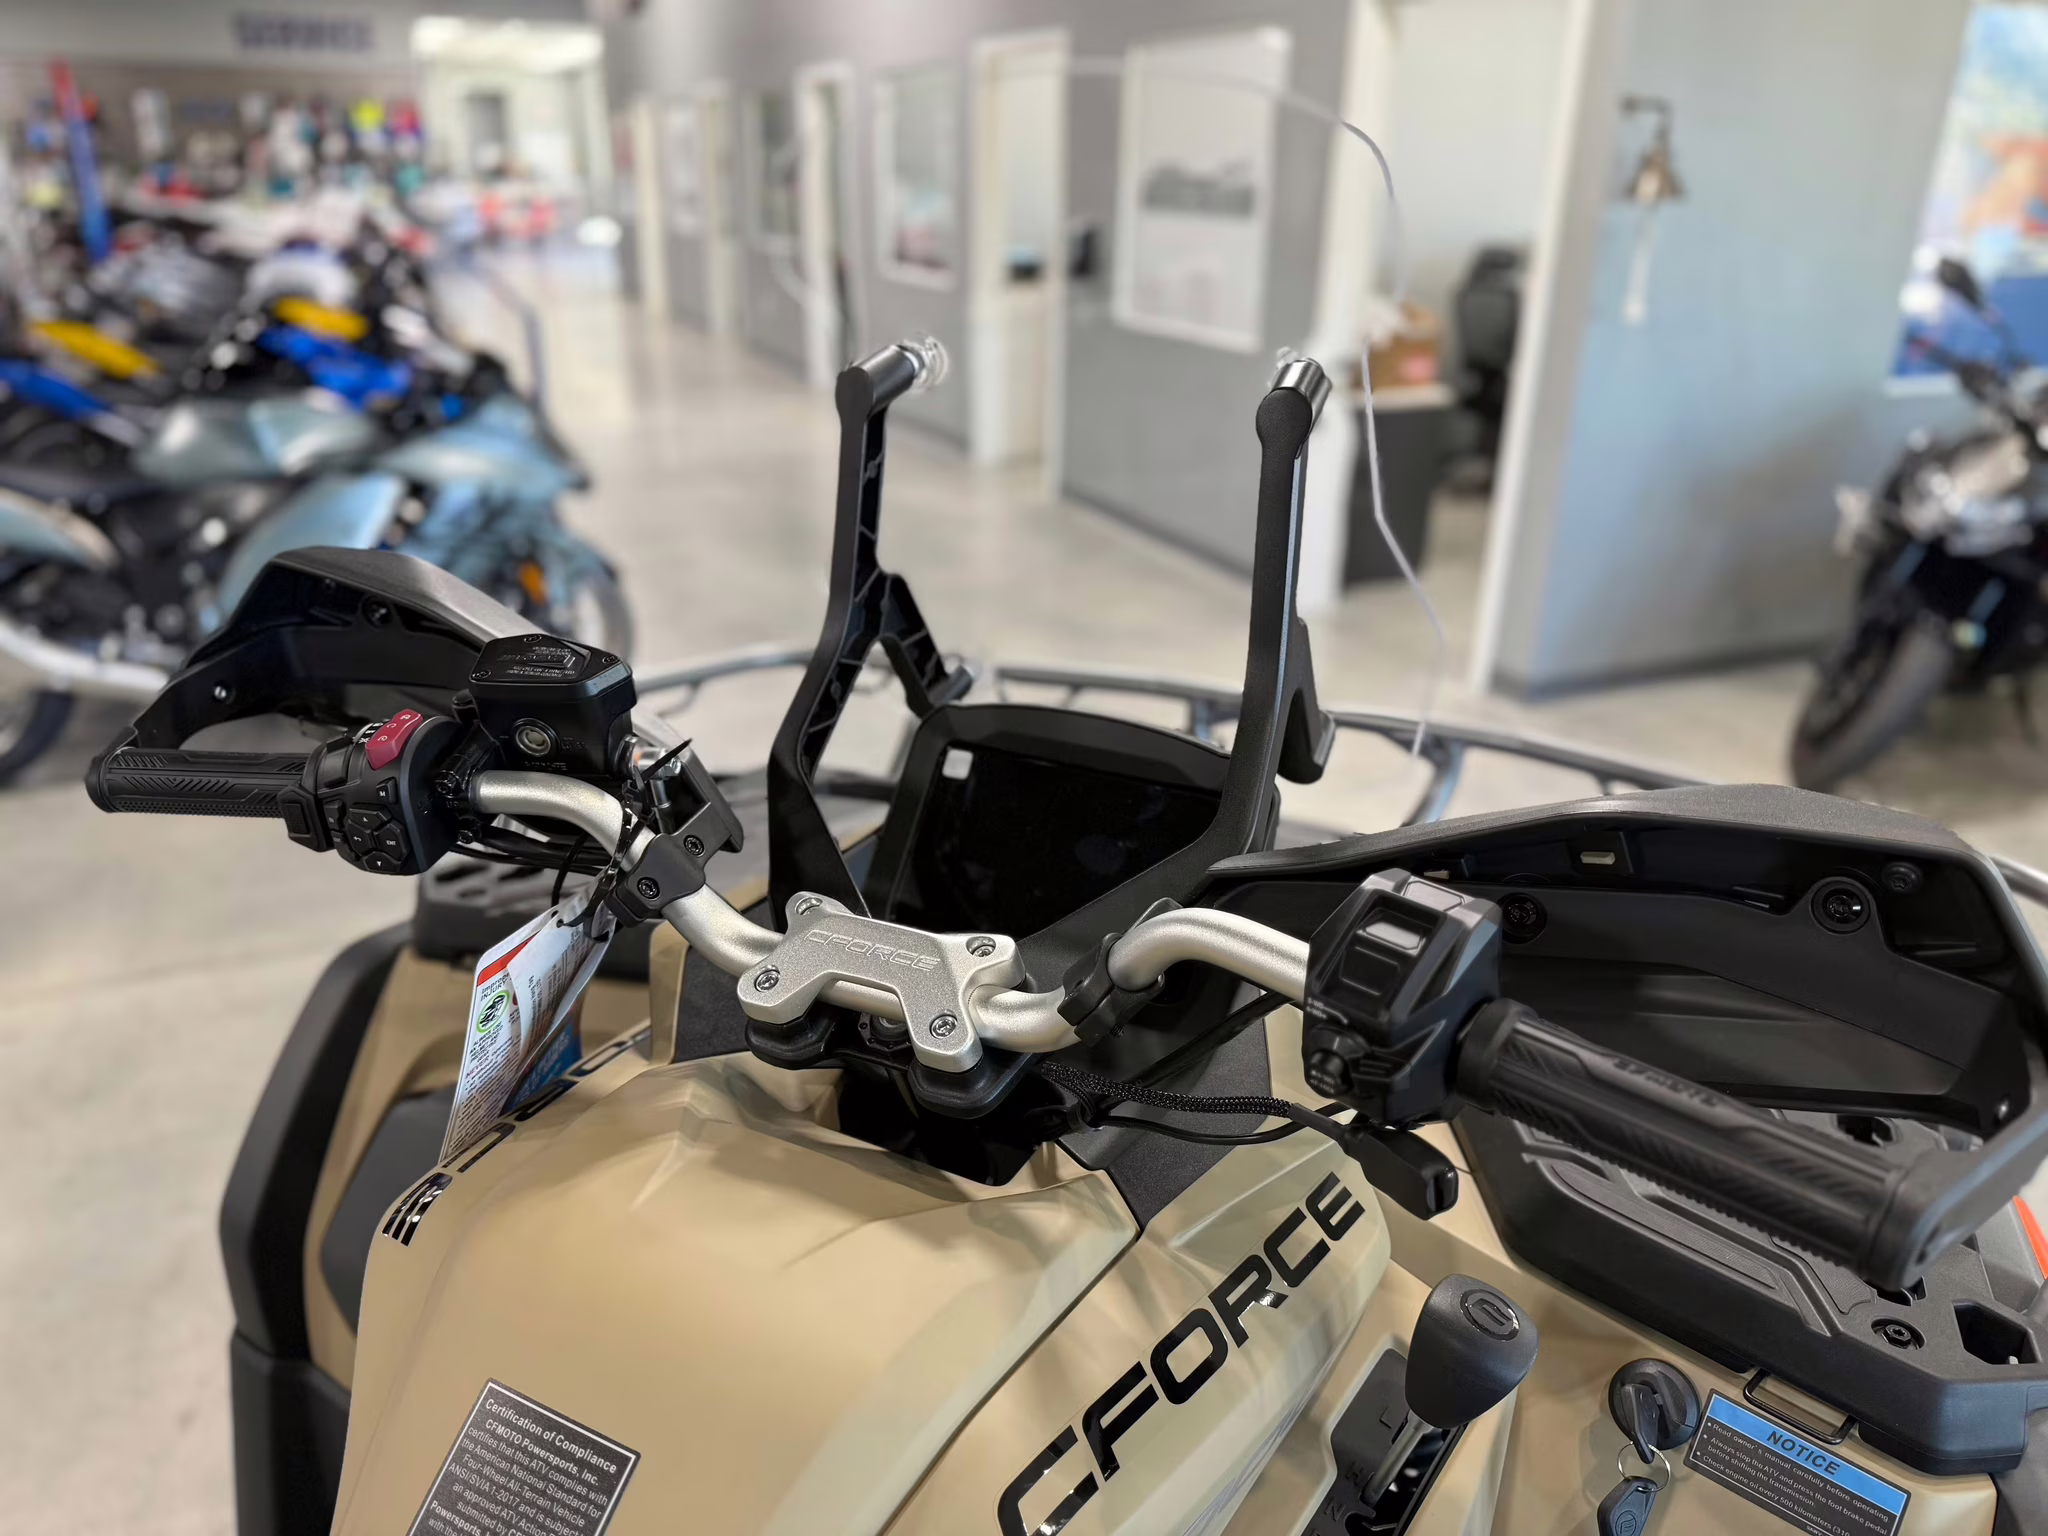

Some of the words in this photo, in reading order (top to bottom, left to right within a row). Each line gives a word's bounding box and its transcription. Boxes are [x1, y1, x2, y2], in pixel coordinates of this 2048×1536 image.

[804, 930, 940, 971] CFORCE
[998, 1171, 1366, 1536] CFORCE
[466, 1425, 499, 1448] certifies
[497, 1441, 516, 1457] that
[513, 1450, 531, 1466] this
[529, 1458, 550, 1475] ATV
[547, 1468, 590, 1497] complies
[587, 1489, 609, 1506] with
[484, 1398, 545, 1436] Certification
[542, 1428, 557, 1442] of
[553, 1434, 619, 1476] Compliance
[484, 1418, 524, 1445] CFMOTO
[520, 1437, 583, 1477] Powersports,
[581, 1468, 602, 1486] Inc.
[1707, 1444, 1731, 1461] before
[1729, 1457, 1757, 1476] shifting
[1756, 1471, 1769, 1482] the
[1712, 1423, 1732, 1438] Read
[1764, 1451, 1792, 1470] manual
[1792, 1466, 1825, 1488] carefully
[1825, 1483, 1851, 1501] before
[1766, 1429, 1841, 1477] NOTICE
[447, 1461, 493, 1493] ANSI/SVIA
[489, 1485, 521, 1508] 1-2017
[518, 1501, 537, 1518] and
[535, 1510, 547, 1523] is
[452, 1482, 465, 1494] an
[462, 1488, 503, 1516] approved
[499, 1507, 521, 1525] ATV
[461, 1437, 476, 1451] the
[472, 1444, 513, 1471] American
[509, 1464, 548, 1490] National
[545, 1483, 589, 1512] Standard
[586, 1504, 603, 1519] for
[461, 1453, 510, 1486] Four-Wheel
[506, 1478, 554, 1509] All-Terrain
[550, 1502, 588, 1528] Vehicle
[1702, 1454, 1726, 1471] Check
[1724, 1467, 1750, 1485] engine
[1749, 1480, 1760, 1490] oil
[1758, 1486, 1780, 1501] every
[1779, 1496, 1794, 1509] 500
[1793, 1504, 1833, 1530] kilometers
[1710, 1437, 1737, 1455] Always
[1734, 1450, 1752, 1464] stop
[1751, 1459, 1765, 1470] the
[1763, 1465, 1780, 1477] ATV
[1778, 1473, 1794, 1486] and
[1792, 1482, 1814, 1498] press
[1814, 1492, 1828, 1504] the
[1826, 1499, 1843, 1512] foot
[1842, 1507, 1866, 1524] brake
[1864, 1519, 1889, 1536] pedal
[455, 1500, 499, 1529] submitted
[494, 1521, 509, 1536] by
